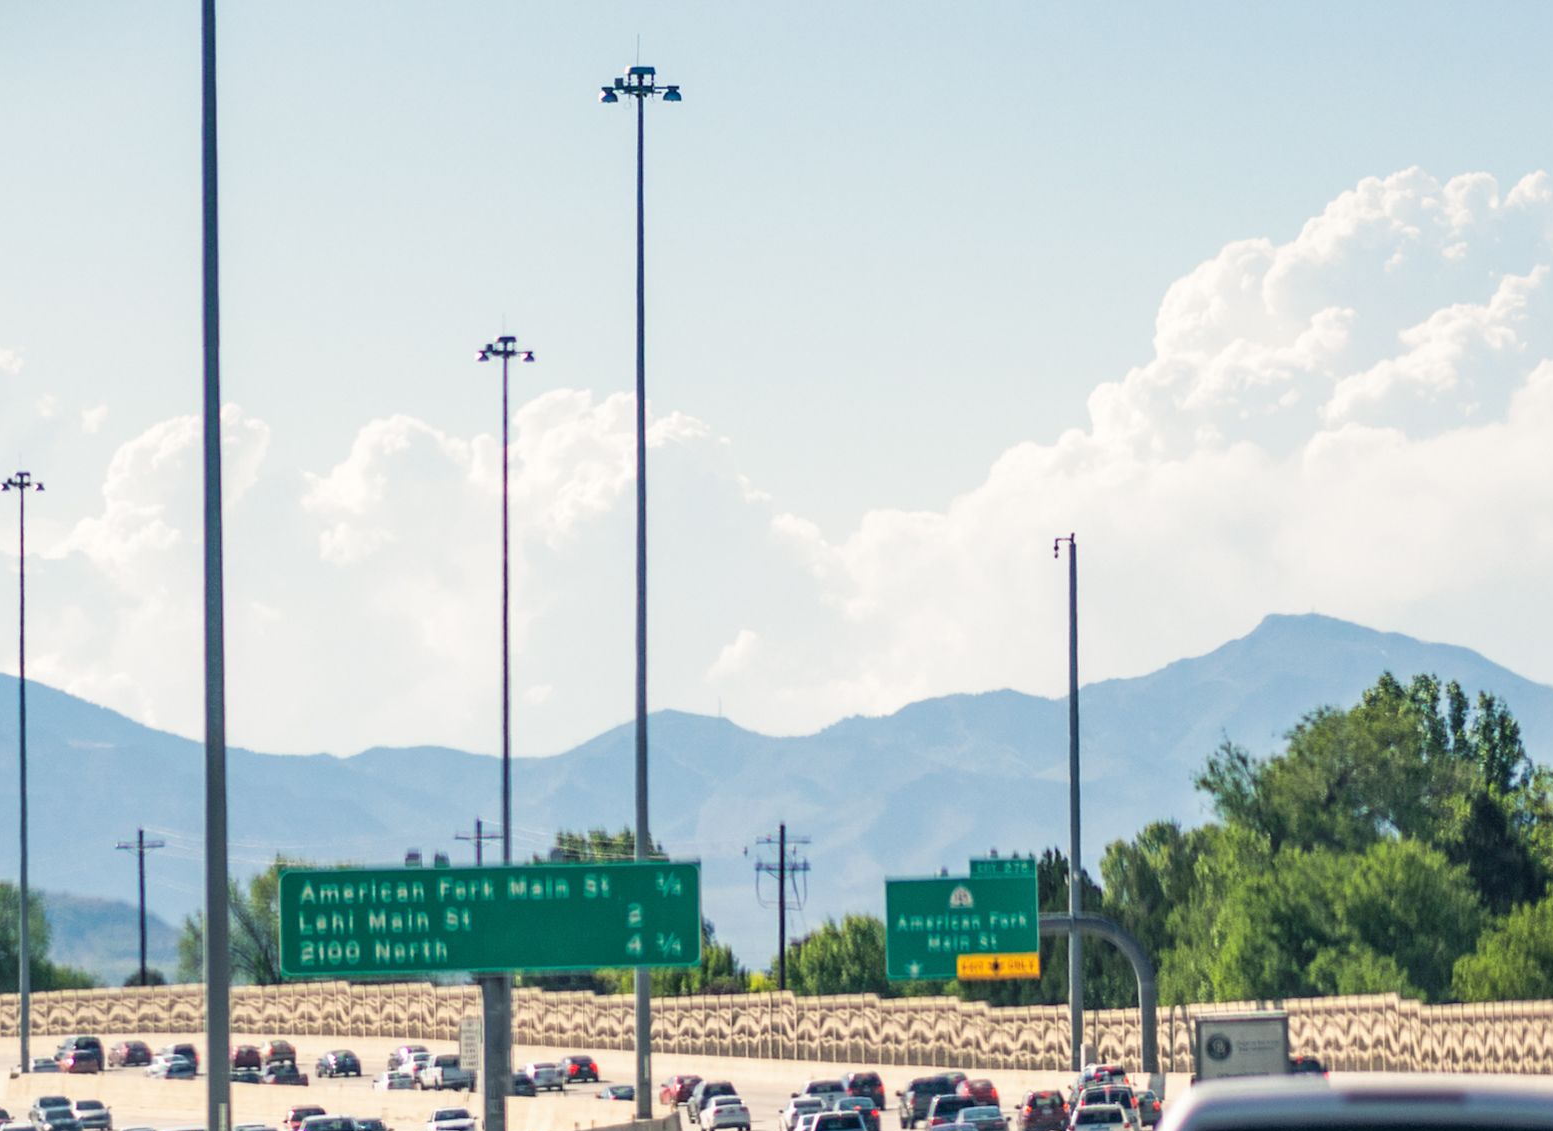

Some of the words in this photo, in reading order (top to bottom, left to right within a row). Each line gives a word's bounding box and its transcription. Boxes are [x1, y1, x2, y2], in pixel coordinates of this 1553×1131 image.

[300, 879, 426, 904] American
[437, 875, 495, 902] Fork
[507, 875, 570, 900] Main
[584, 873, 610, 898] St
[299, 908, 354, 934] Lehi
[368, 907, 429, 934] Main
[445, 906, 472, 932] St
[627, 902, 644, 929] 2
[896, 912, 982, 933] American
[989, 911, 1028, 930] Fork
[300, 938, 361, 966] 2100
[375, 937, 448, 965] North
[625, 932, 644, 957] 4
[927, 932, 970, 953] Main
[979, 930, 998, 951] St
